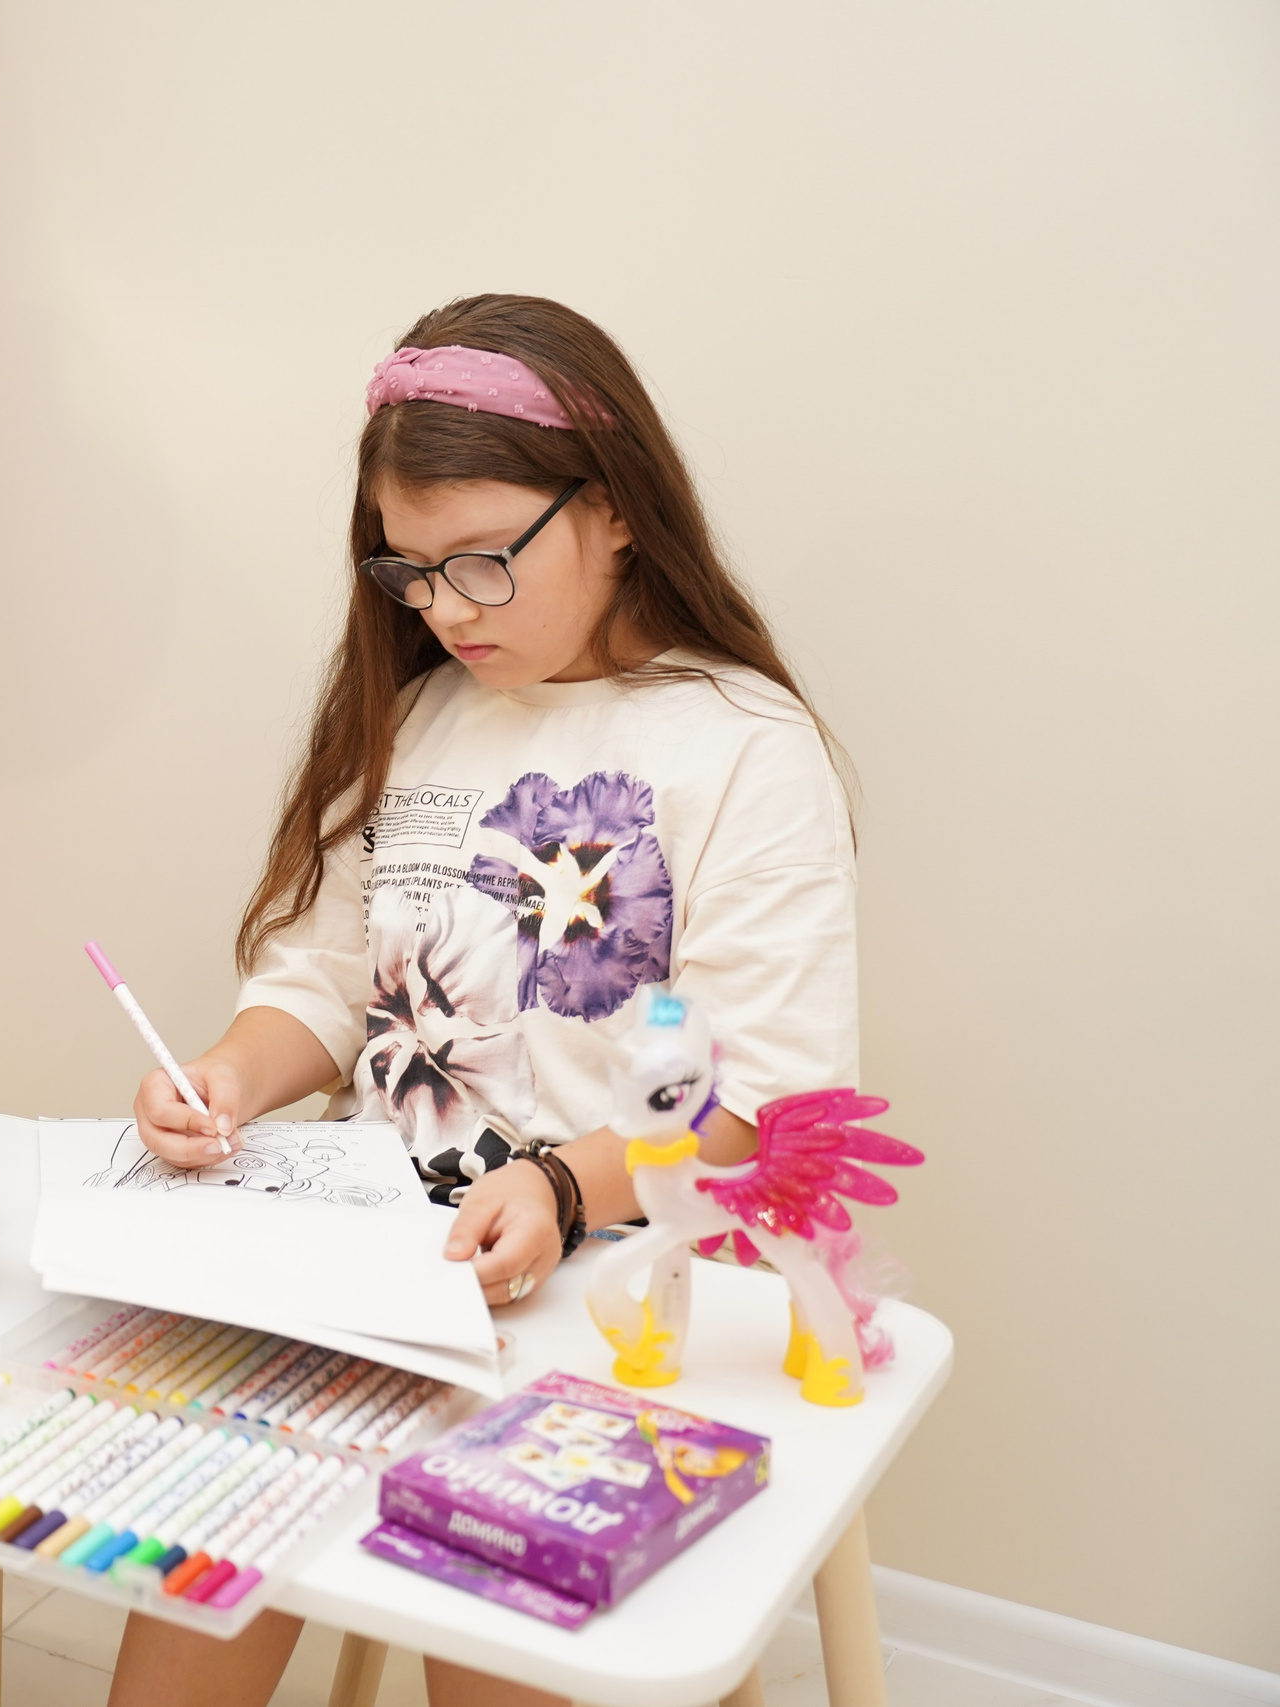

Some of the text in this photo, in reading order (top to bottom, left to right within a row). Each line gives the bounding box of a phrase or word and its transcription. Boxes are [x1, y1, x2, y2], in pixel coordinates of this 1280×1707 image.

[413, 790, 472, 808] LOCALS
[387, 864, 396, 874] AS
[396, 863, 401, 873] A
[421, 862, 431, 872] OR
[473, 872, 481, 883] IS
[482, 873, 496, 886] THE
